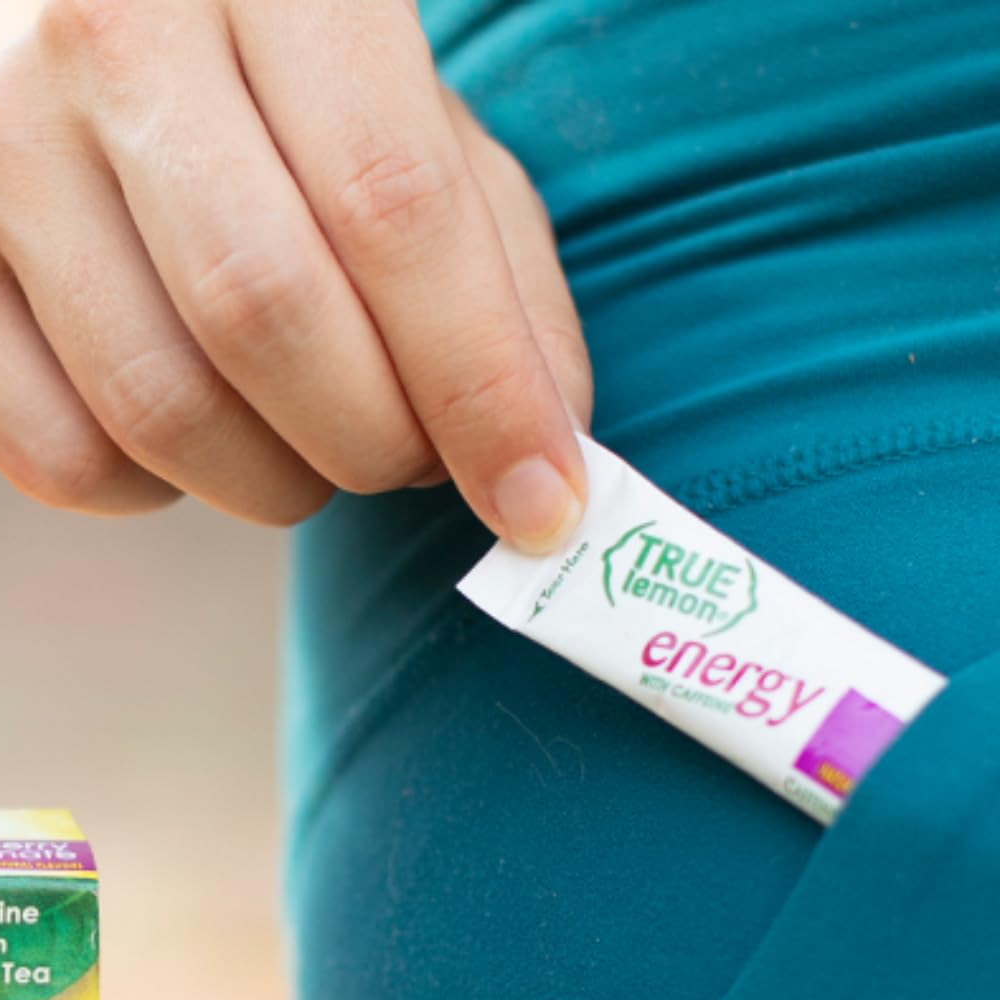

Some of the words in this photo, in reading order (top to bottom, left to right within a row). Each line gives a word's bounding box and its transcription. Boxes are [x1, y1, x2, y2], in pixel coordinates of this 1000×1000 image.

[621, 568, 719, 624] lemon
[638, 532, 743, 599] TRUE
[640, 630, 826, 727] energy
